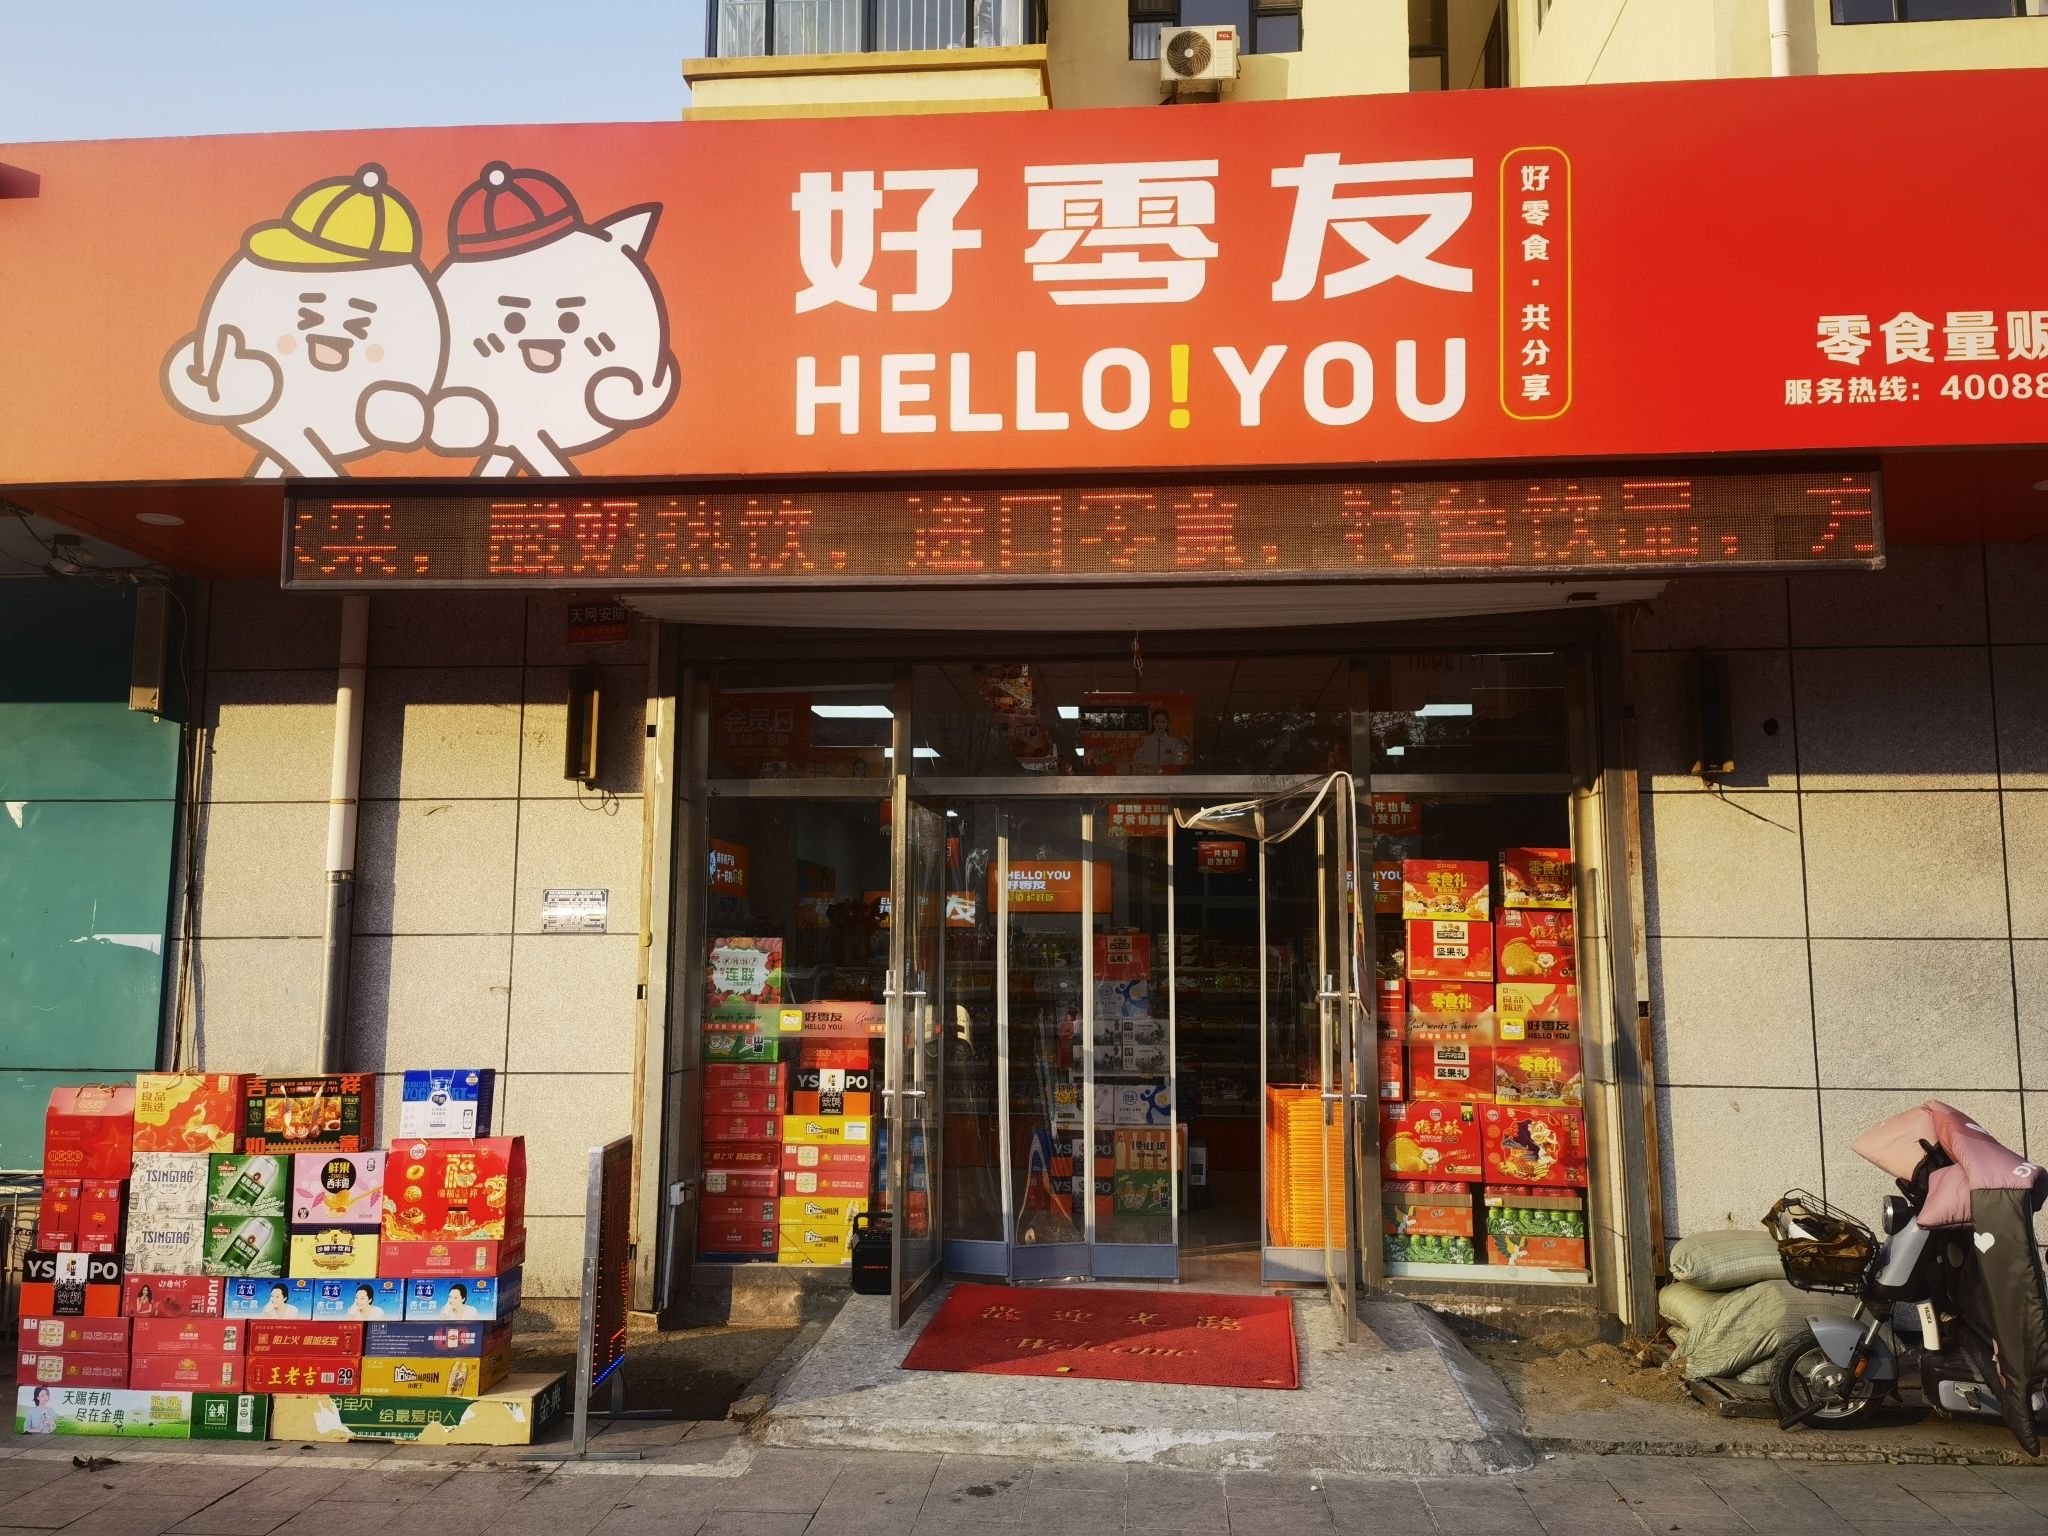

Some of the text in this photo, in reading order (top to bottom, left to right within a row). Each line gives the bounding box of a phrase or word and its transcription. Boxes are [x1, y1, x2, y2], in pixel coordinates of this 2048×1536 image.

[791, 152, 1475, 315] 好零友
[1426, 872, 1467, 888] 零食礼
[1431, 992, 1472, 1009] 零食礼
[804, 1012, 843, 1022] 好零友
[1527, 1020, 1570, 1031] 好零友
[1519, 1056, 1561, 1073] 零食礼
[1437, 1068, 1467, 1078] 坚果礼
[846, 1075, 868, 1089] PO
[141, 1092, 166, 1101] 良品
[27, 1260, 118, 1280] YS PO
[231, 1301, 258, 1310] 杏仁露
[316, 1300, 344, 1311] 杏仁露
[272, 1335, 300, 1345] 怕上火
[1003, 1336, 1198, 1358] Welcome
[268, 1366, 317, 1386] 王老吉
[338, 1368, 353, 1378] 20
[208, 1403, 226, 1417] 金典
[539, 1383, 561, 1425] 金典
[75, 1407, 125, 1424] 尽在金典
[379, 1408, 456, 1423] 给最爱的人
